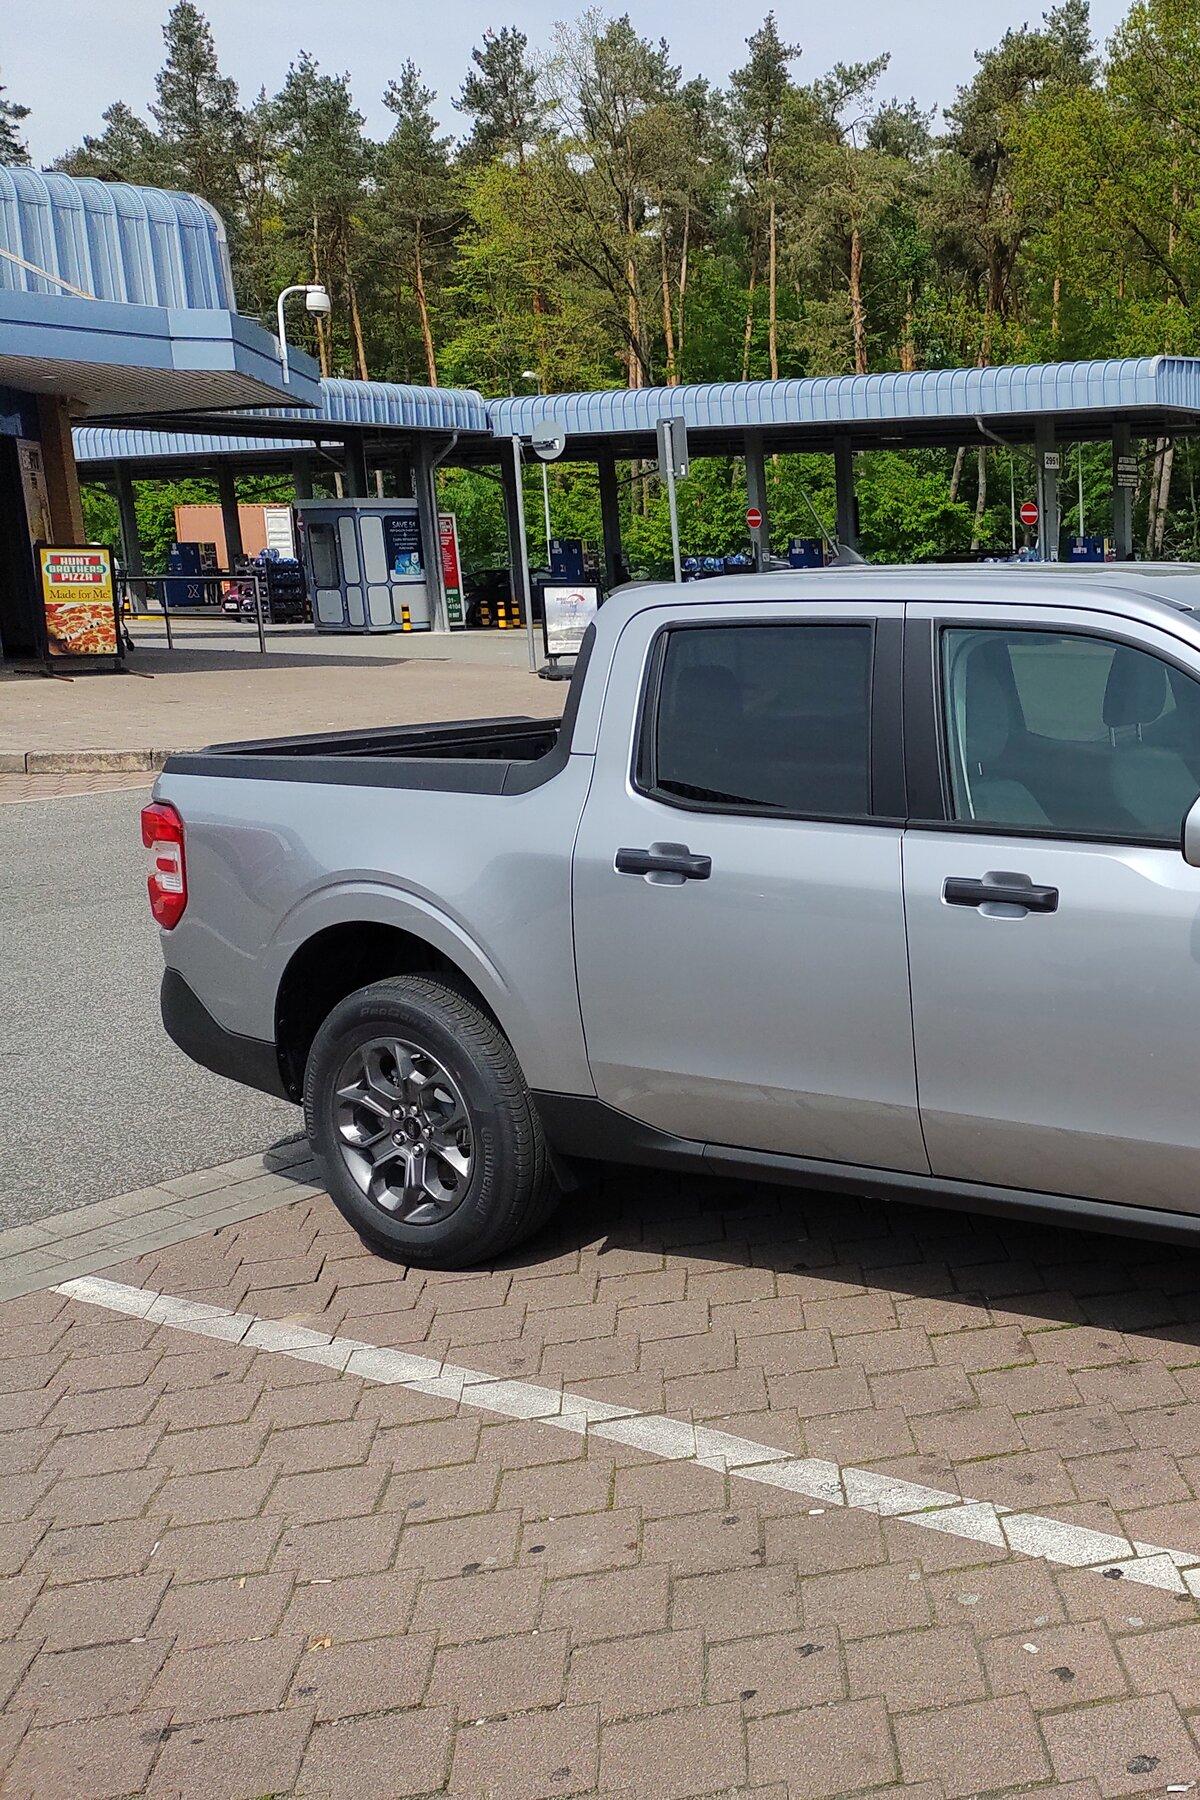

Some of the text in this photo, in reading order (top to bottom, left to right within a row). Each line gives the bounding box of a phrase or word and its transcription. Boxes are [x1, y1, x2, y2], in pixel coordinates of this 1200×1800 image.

[1045, 456, 1059, 466] 2951
[392, 521, 408, 529] SAVE
[60, 557, 90, 565] HUNT
[48, 565, 104, 573] BROTHERS
[61, 573, 93, 581] PIZZA
[50, 589, 76, 599] Made
[78, 589, 91, 599] for
